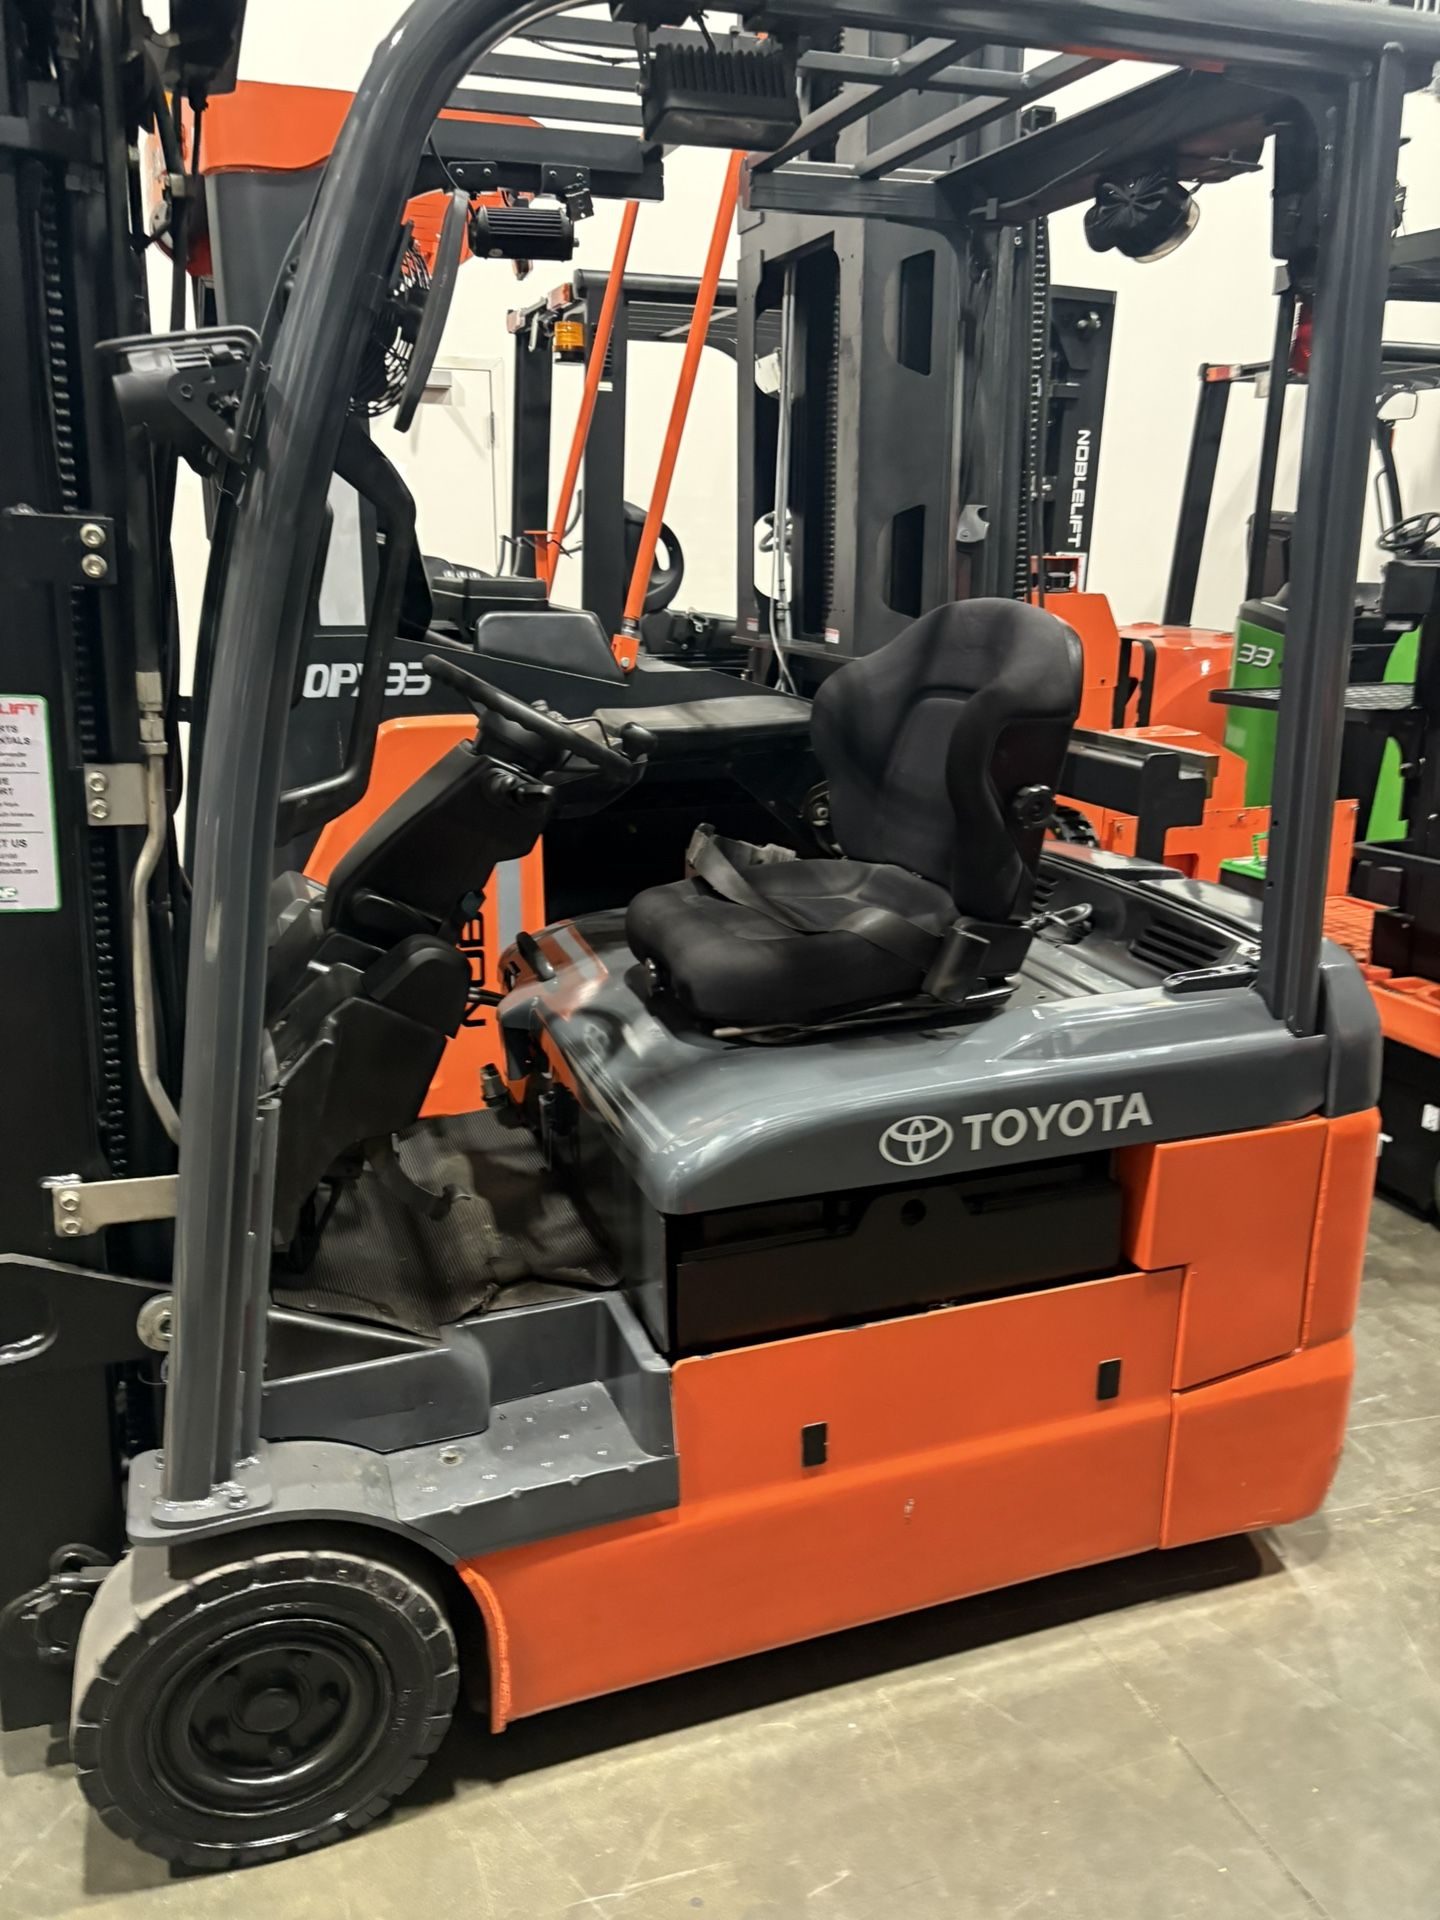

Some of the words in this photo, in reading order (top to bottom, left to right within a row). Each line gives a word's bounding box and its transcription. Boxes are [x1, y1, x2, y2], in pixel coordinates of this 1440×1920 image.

[1067, 429, 1092, 549] NOBLELIFT
[1237, 643, 1275, 668] 33
[0, 703, 38, 716] LIFT
[962, 1092, 1153, 1151] TOYOTA
